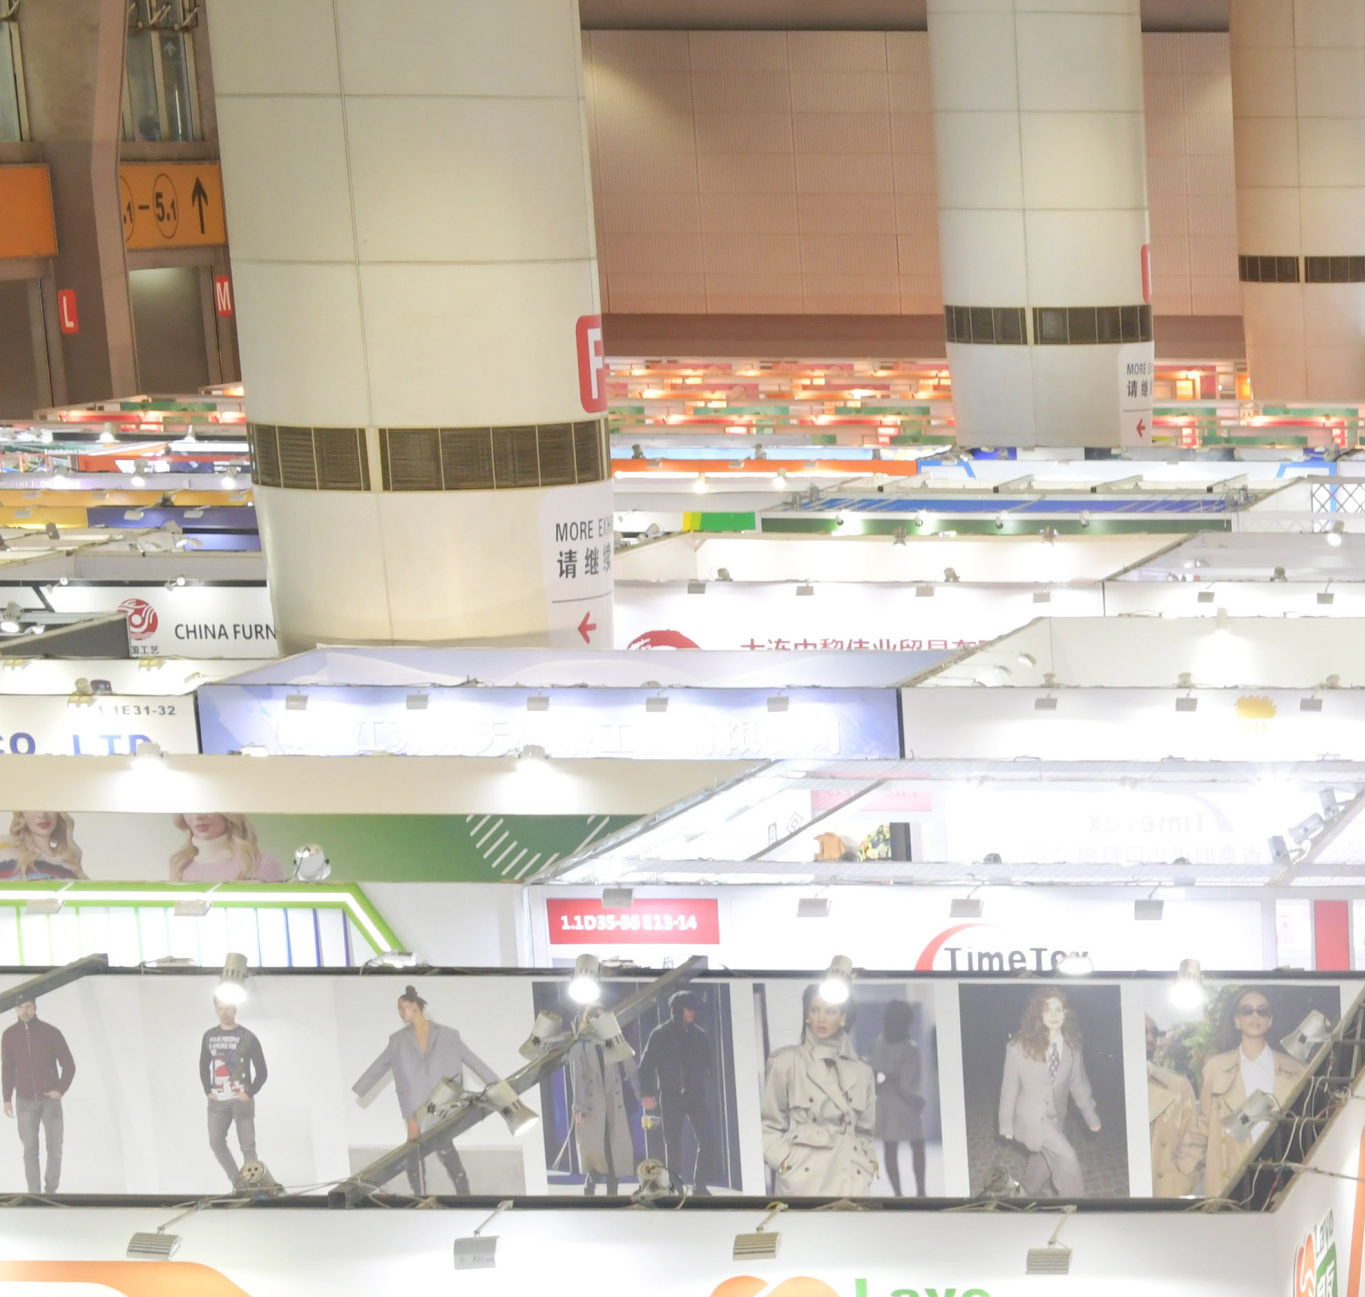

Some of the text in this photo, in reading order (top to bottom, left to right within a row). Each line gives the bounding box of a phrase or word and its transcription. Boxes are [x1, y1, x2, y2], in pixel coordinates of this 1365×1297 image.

[154, 191, 177, 222] 5.1
[62, 295, 74, 328] L
[215, 280, 232, 312] M
[555, 521, 593, 542] MORE
[174, 624, 229, 640] CHINA
